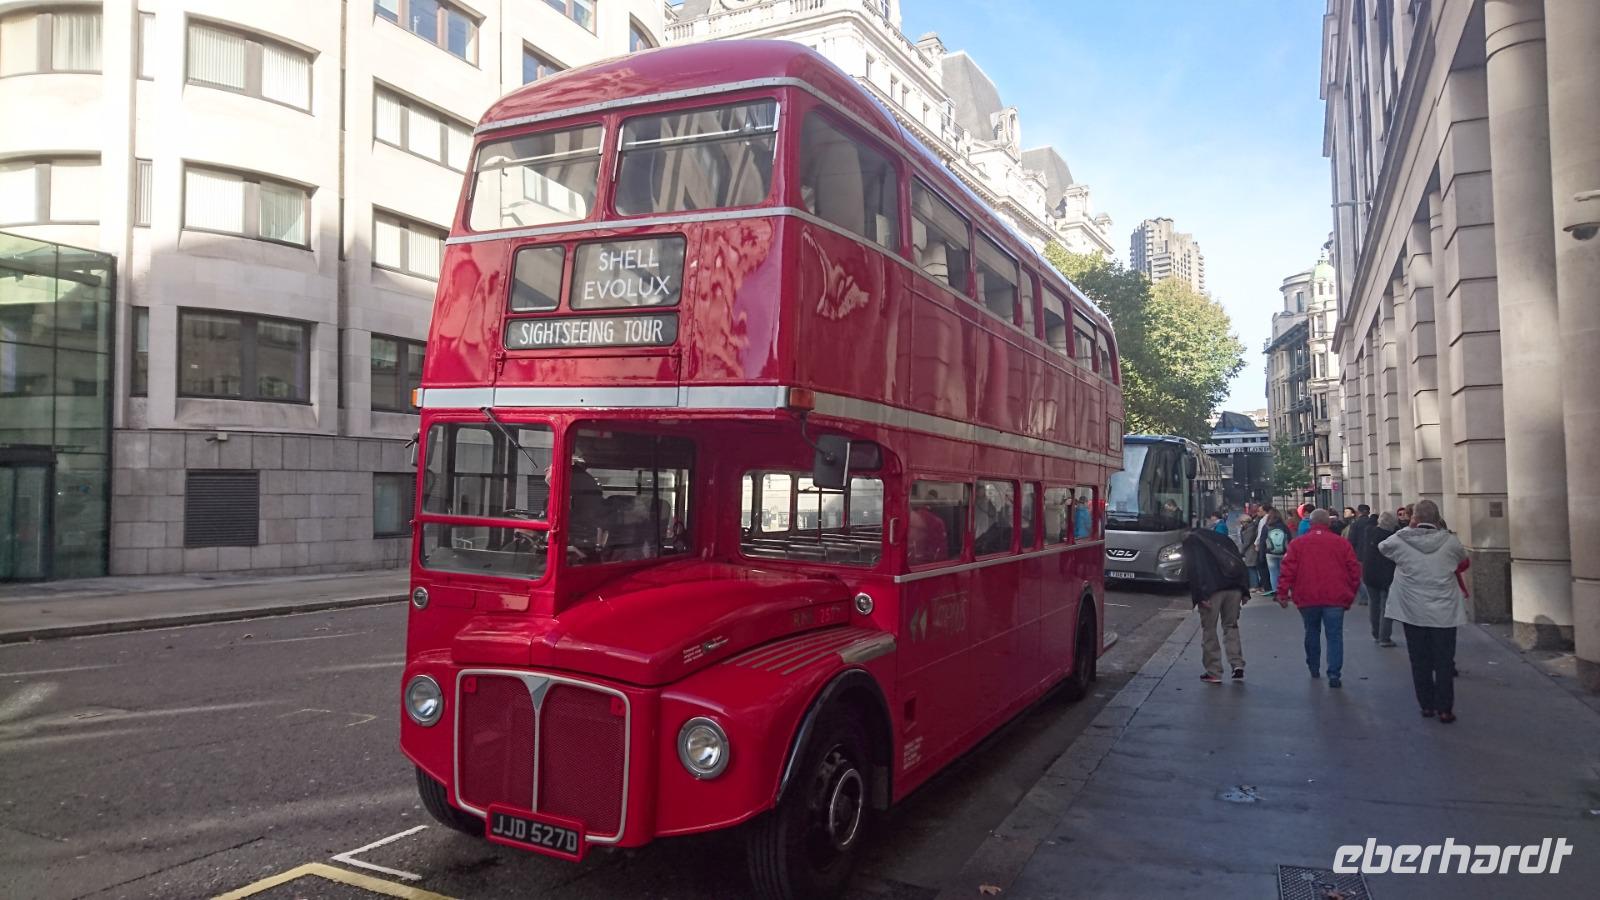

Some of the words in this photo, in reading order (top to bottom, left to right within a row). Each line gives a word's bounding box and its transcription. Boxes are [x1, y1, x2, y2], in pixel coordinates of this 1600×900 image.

[599, 248, 659, 271] SHELL
[584, 275, 671, 300] EVOLUX
[519, 321, 614, 345] SIGHTSEEING
[624, 319, 664, 342] TOUR
[1108, 549, 1133, 557] VDL
[493, 815, 526, 839] JJD
[531, 823, 578, 852] 527D
